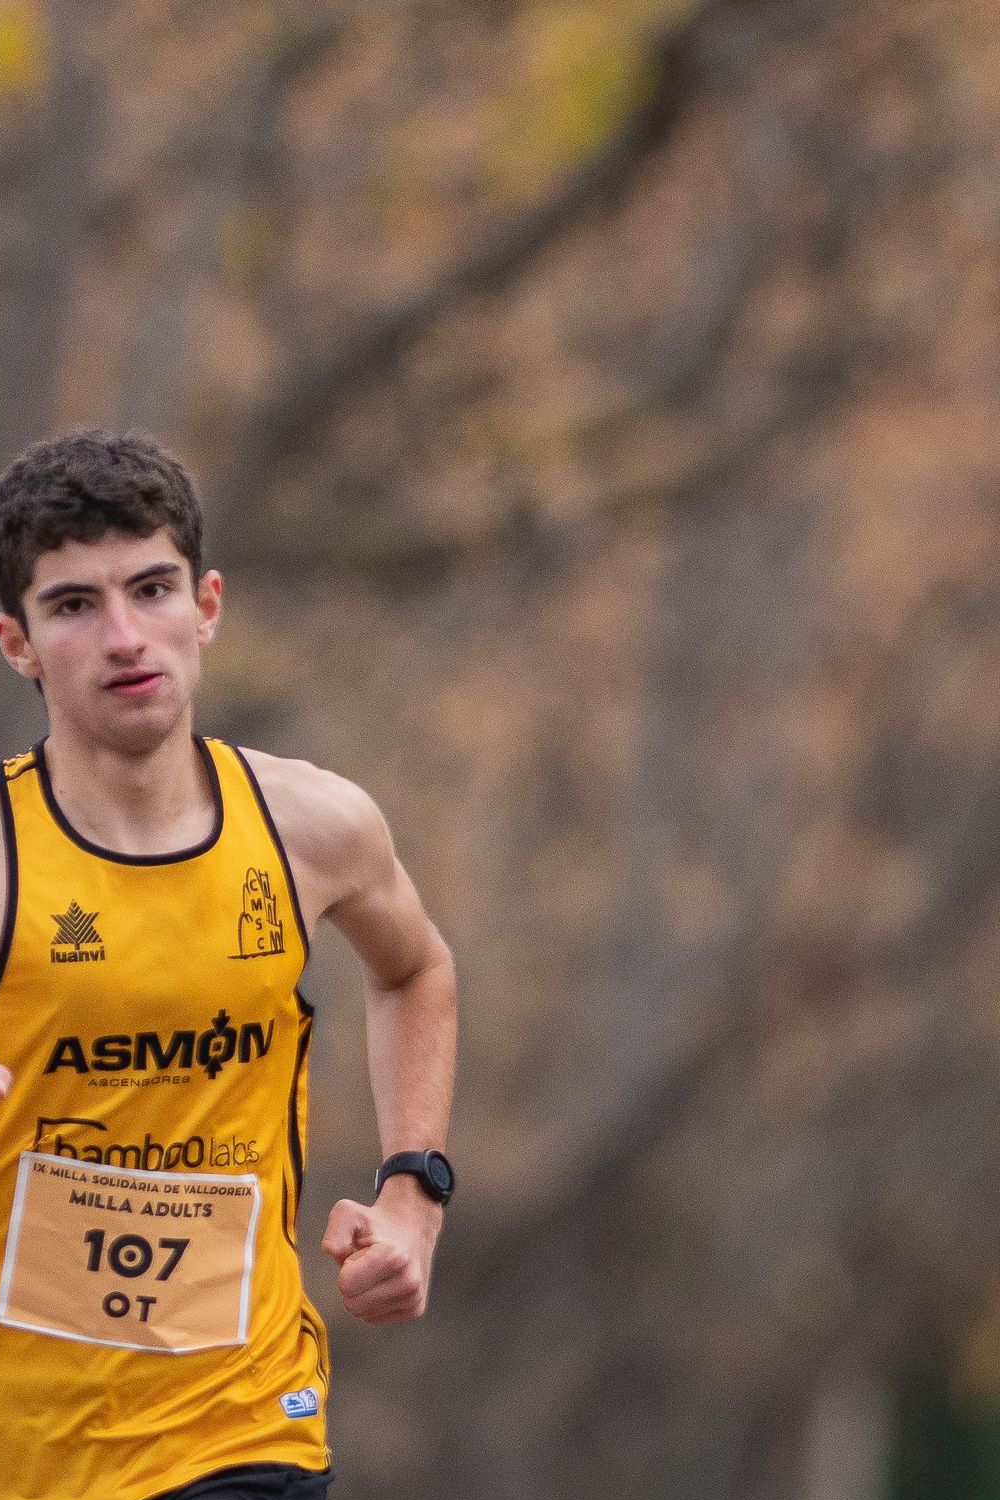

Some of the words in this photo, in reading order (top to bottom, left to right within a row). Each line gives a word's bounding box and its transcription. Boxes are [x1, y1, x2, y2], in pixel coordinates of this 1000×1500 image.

[50, 946, 105, 963] luanvi
[42, 1014, 275, 1076] ASMON
[88, 1075, 191, 1087] ASCENSORES
[210, 1136, 260, 1166] labs
[33, 1162, 46, 1173] IX
[50, 1167, 87, 1183] MILLA
[164, 1184, 180, 1194] DE
[184, 1184, 252, 1197] VALLDOREIX
[69, 1189, 133, 1213] MILLA
[140, 1201, 213, 1218] ADULTS
[84, 1228, 190, 1281] 107
[102, 1291, 157, 1323] OT
